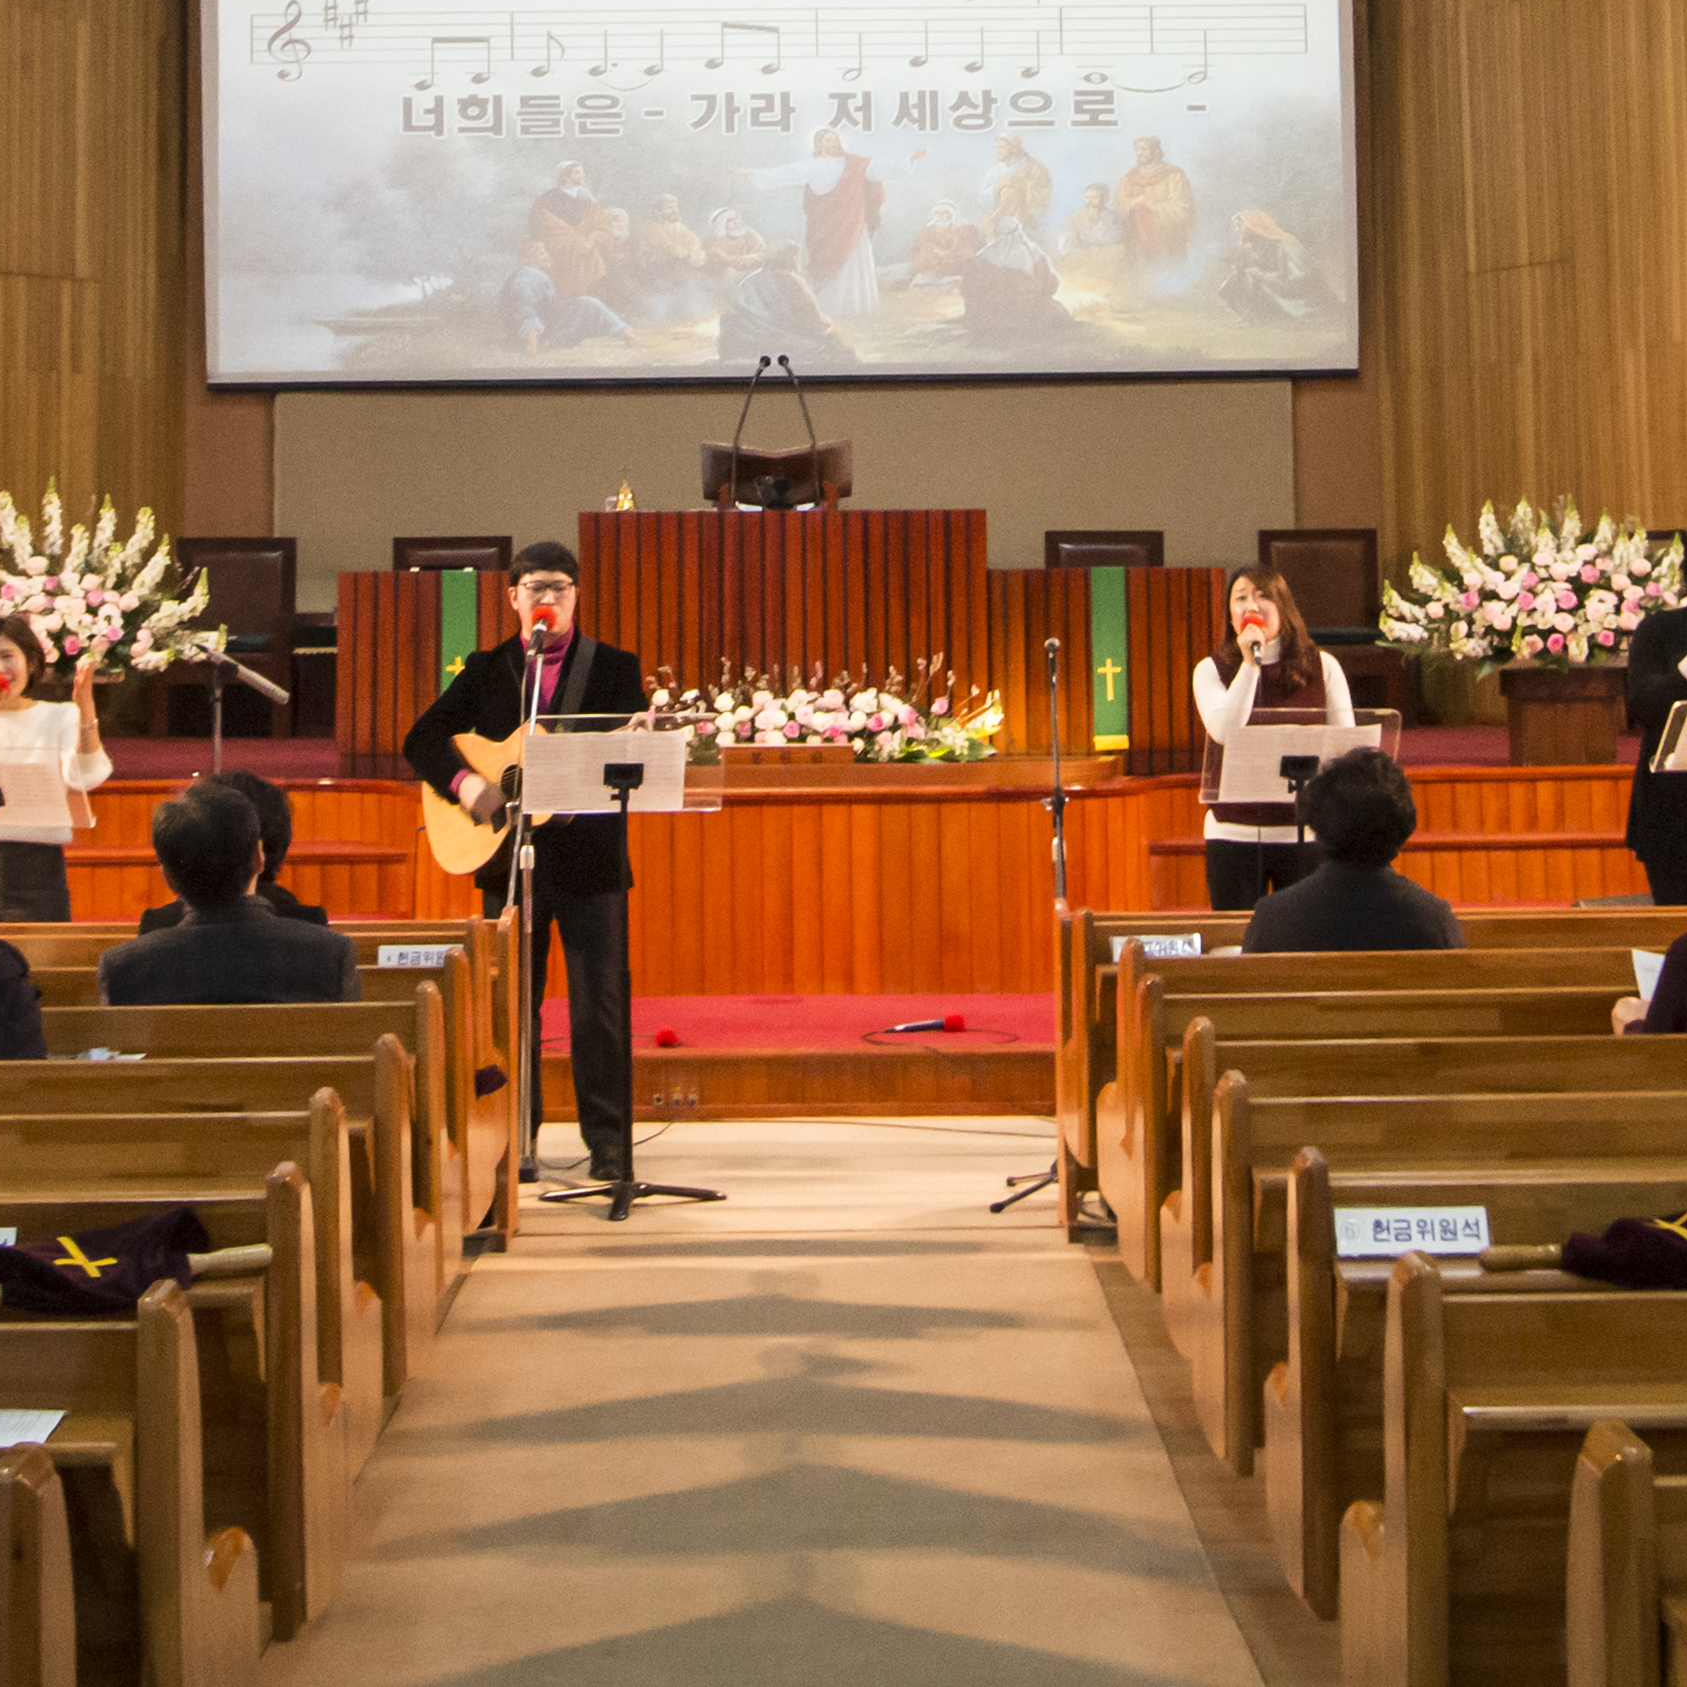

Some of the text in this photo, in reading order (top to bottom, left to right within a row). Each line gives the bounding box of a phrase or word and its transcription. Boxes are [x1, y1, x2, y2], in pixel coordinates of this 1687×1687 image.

[401, 93, 626, 138] 너희들은
[688, 90, 796, 134] 가라
[1372, 1217, 1481, 1243] 헌금위원석
